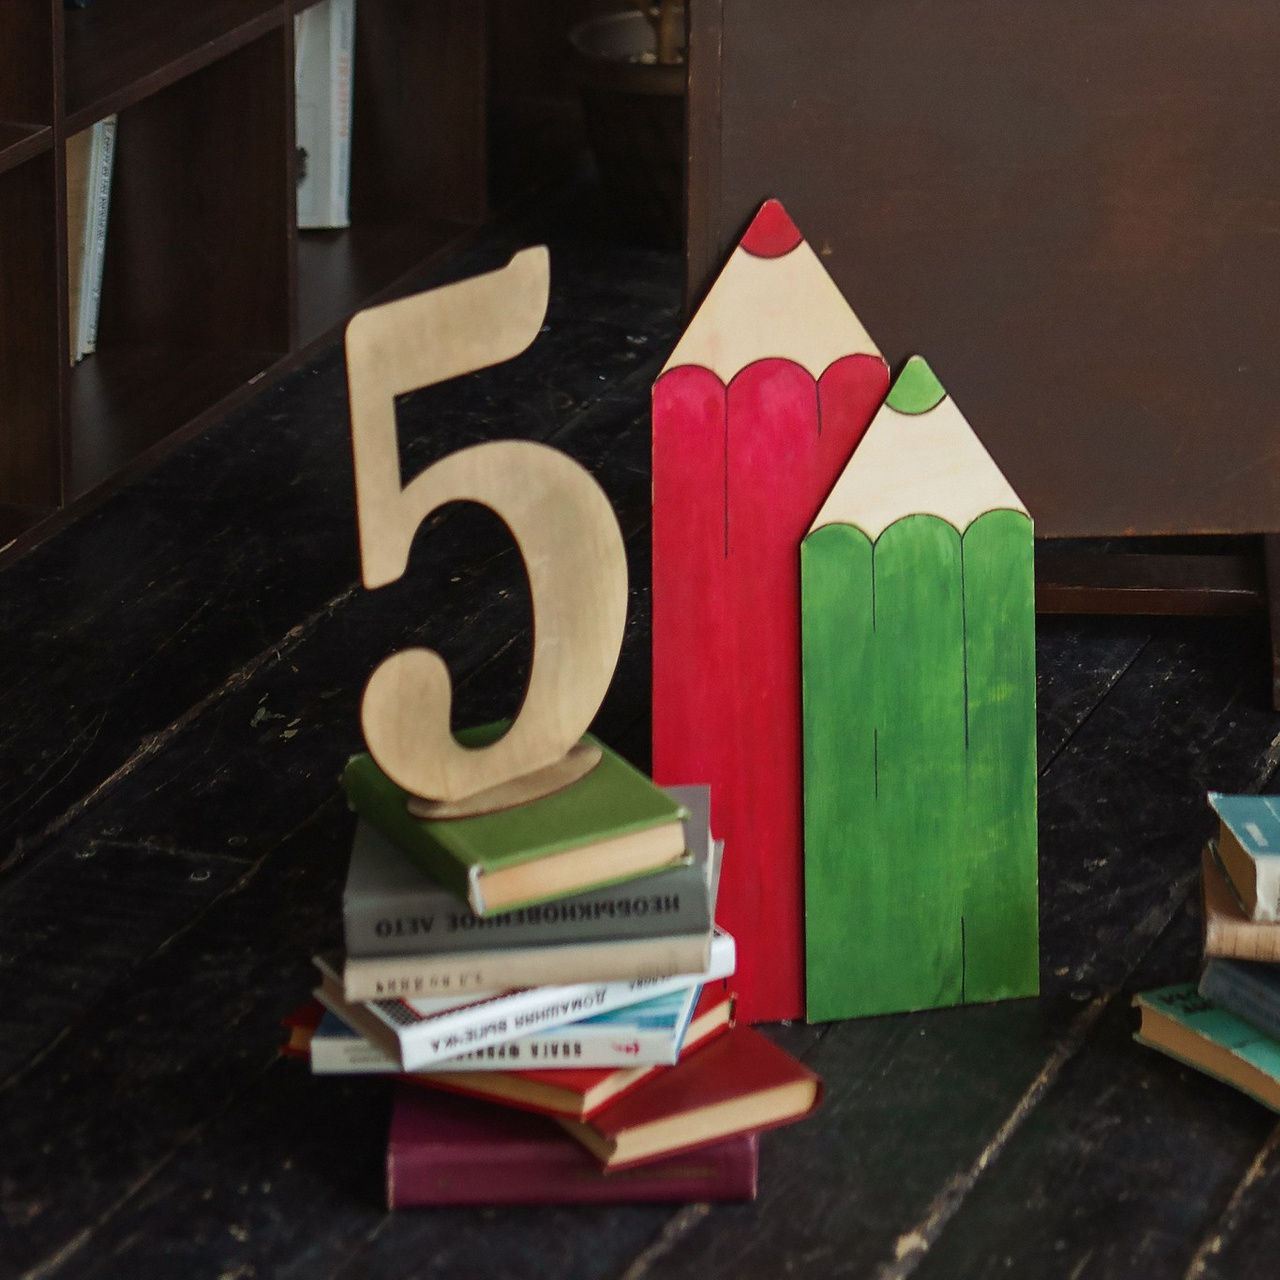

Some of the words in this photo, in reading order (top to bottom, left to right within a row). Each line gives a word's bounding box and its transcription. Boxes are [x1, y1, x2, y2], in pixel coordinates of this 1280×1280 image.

[375, 915, 434, 938] ЛЕТО
[514, 992, 607, 1027] ДОМАШНЯЯ
[429, 1017, 511, 1053] ВЫПЕЧКА
